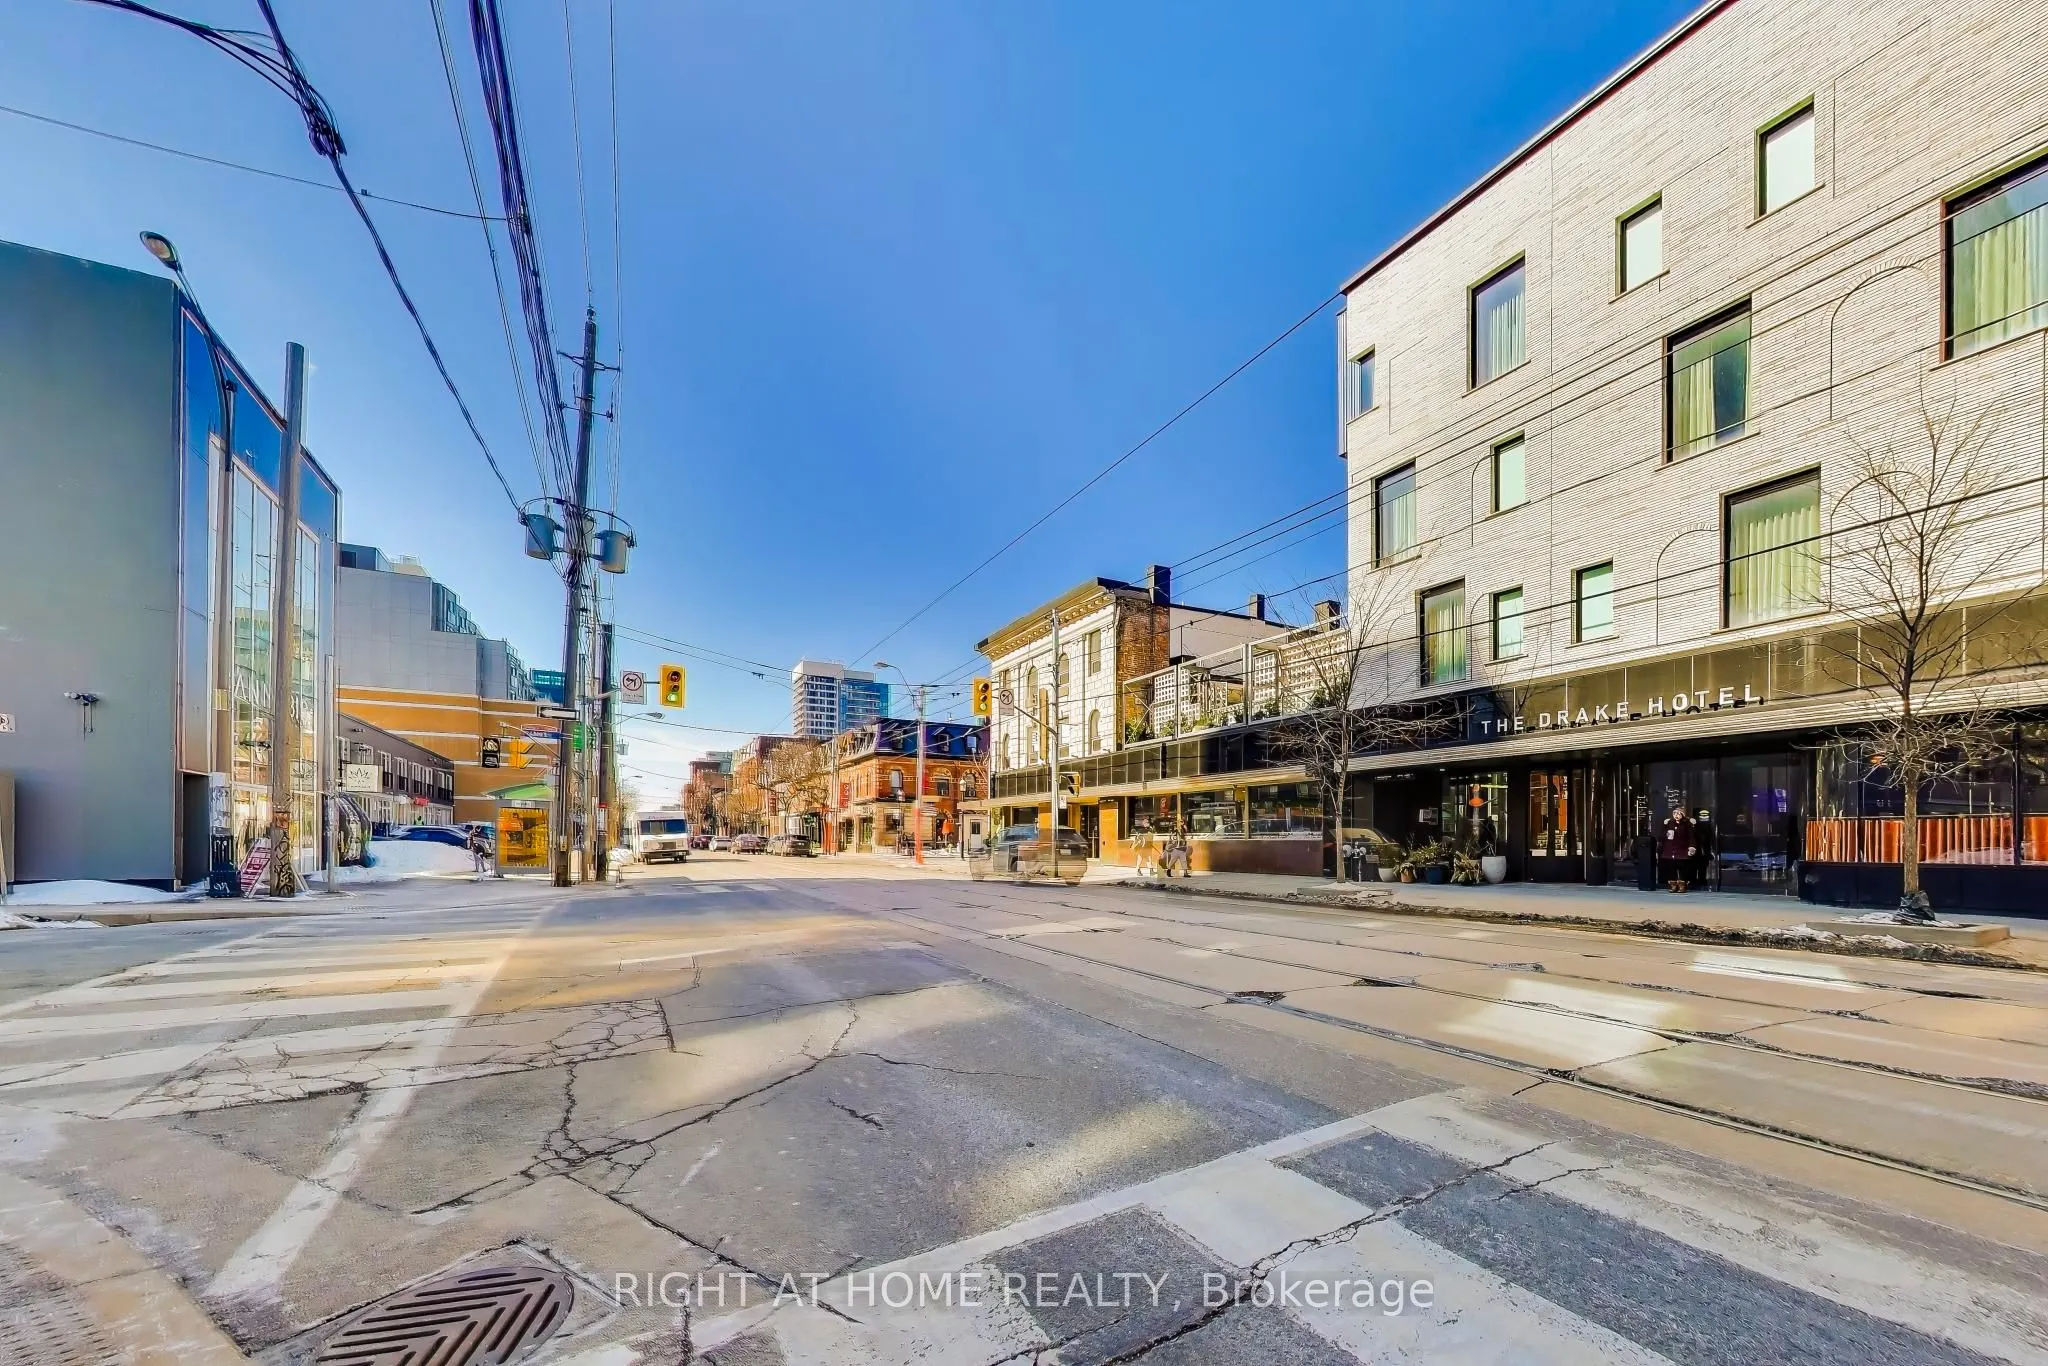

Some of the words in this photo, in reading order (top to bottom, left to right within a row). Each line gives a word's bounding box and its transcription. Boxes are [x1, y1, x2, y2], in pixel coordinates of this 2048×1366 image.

[1481, 716, 1524, 735] THE
[1539, 702, 1629, 728] DRAKE
[1648, 684, 1760, 714] HOTEL
